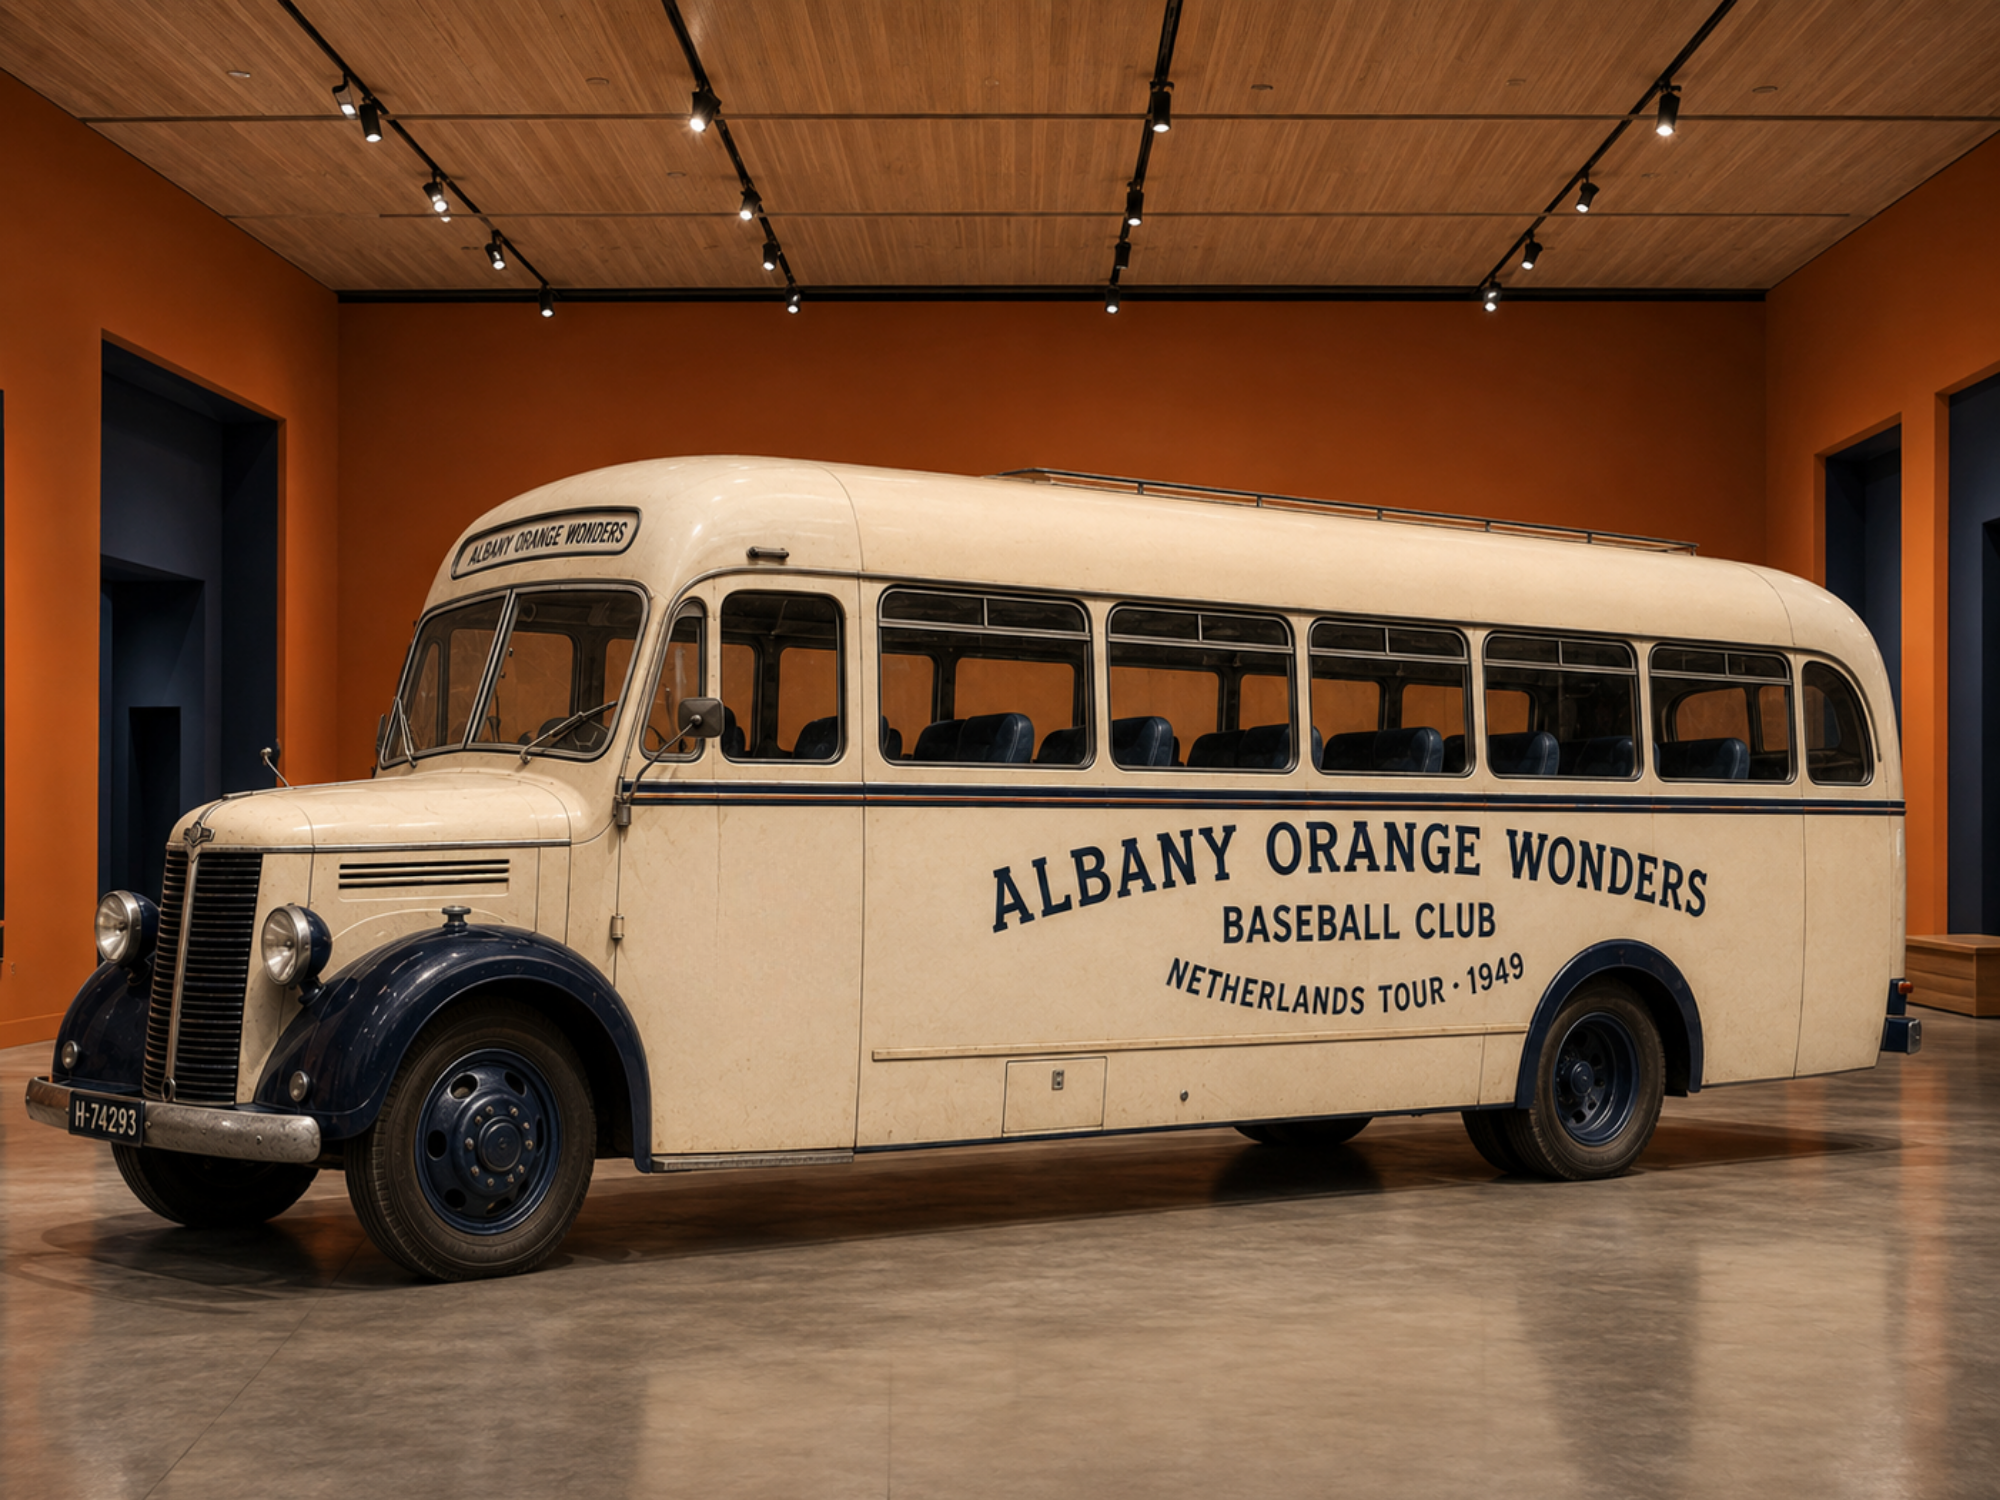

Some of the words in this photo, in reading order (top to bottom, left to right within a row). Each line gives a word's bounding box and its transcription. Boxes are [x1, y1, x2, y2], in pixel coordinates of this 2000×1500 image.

[467, 534, 515, 566] ALBANY
[514, 524, 565, 552] ORANGE
[564, 521, 628, 545] WONDERS
[993, 824, 1237, 933] ALBANY
[1266, 820, 1481, 876] ORANGE
[1506, 828, 1708, 917] WONDERS
[1223, 903, 1400, 944] BASEBALL
[1415, 902, 1496, 939] CLUB
[1165, 957, 1365, 1015] NETHERLANDS
[1378, 976, 1446, 1013] TOUR
[1466, 952, 1525, 995] 1949
[75, 1100, 137, 1136] H-74293
